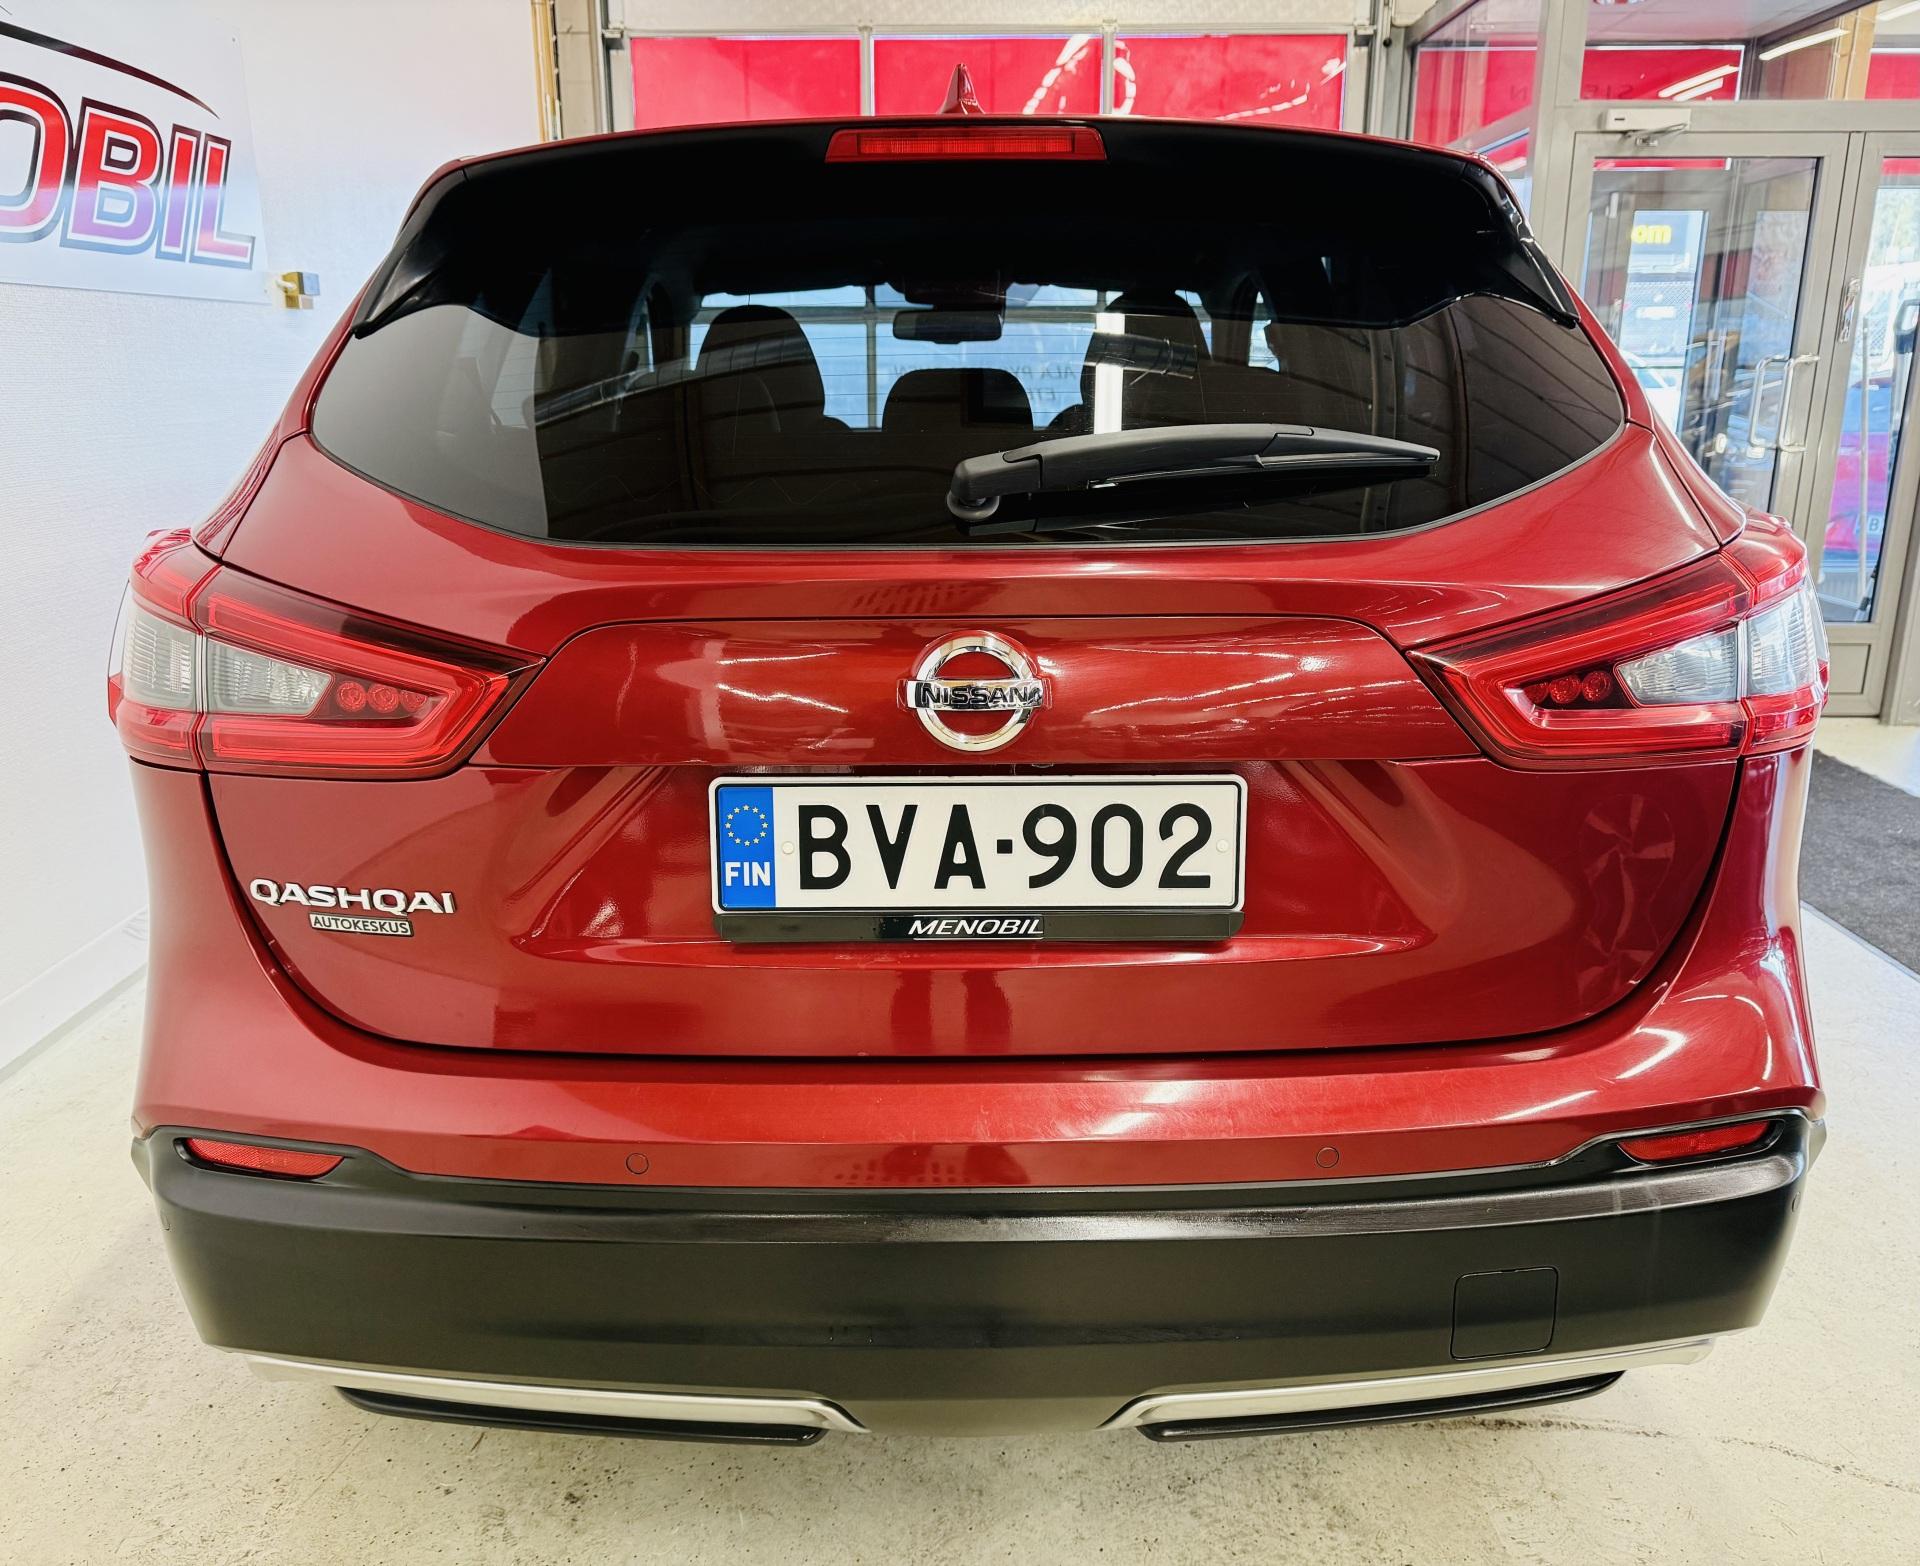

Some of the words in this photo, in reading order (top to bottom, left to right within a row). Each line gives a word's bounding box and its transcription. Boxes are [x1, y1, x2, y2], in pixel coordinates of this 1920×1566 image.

[922, 686, 1029, 705] NISSAN
[798, 803, 1213, 889] BVA-902
[725, 861, 771, 887] FIN
[249, 878, 456, 917] QASHQAI
[312, 916, 410, 935] AUTOKESKUS
[907, 919, 1044, 935] MENOBIL
